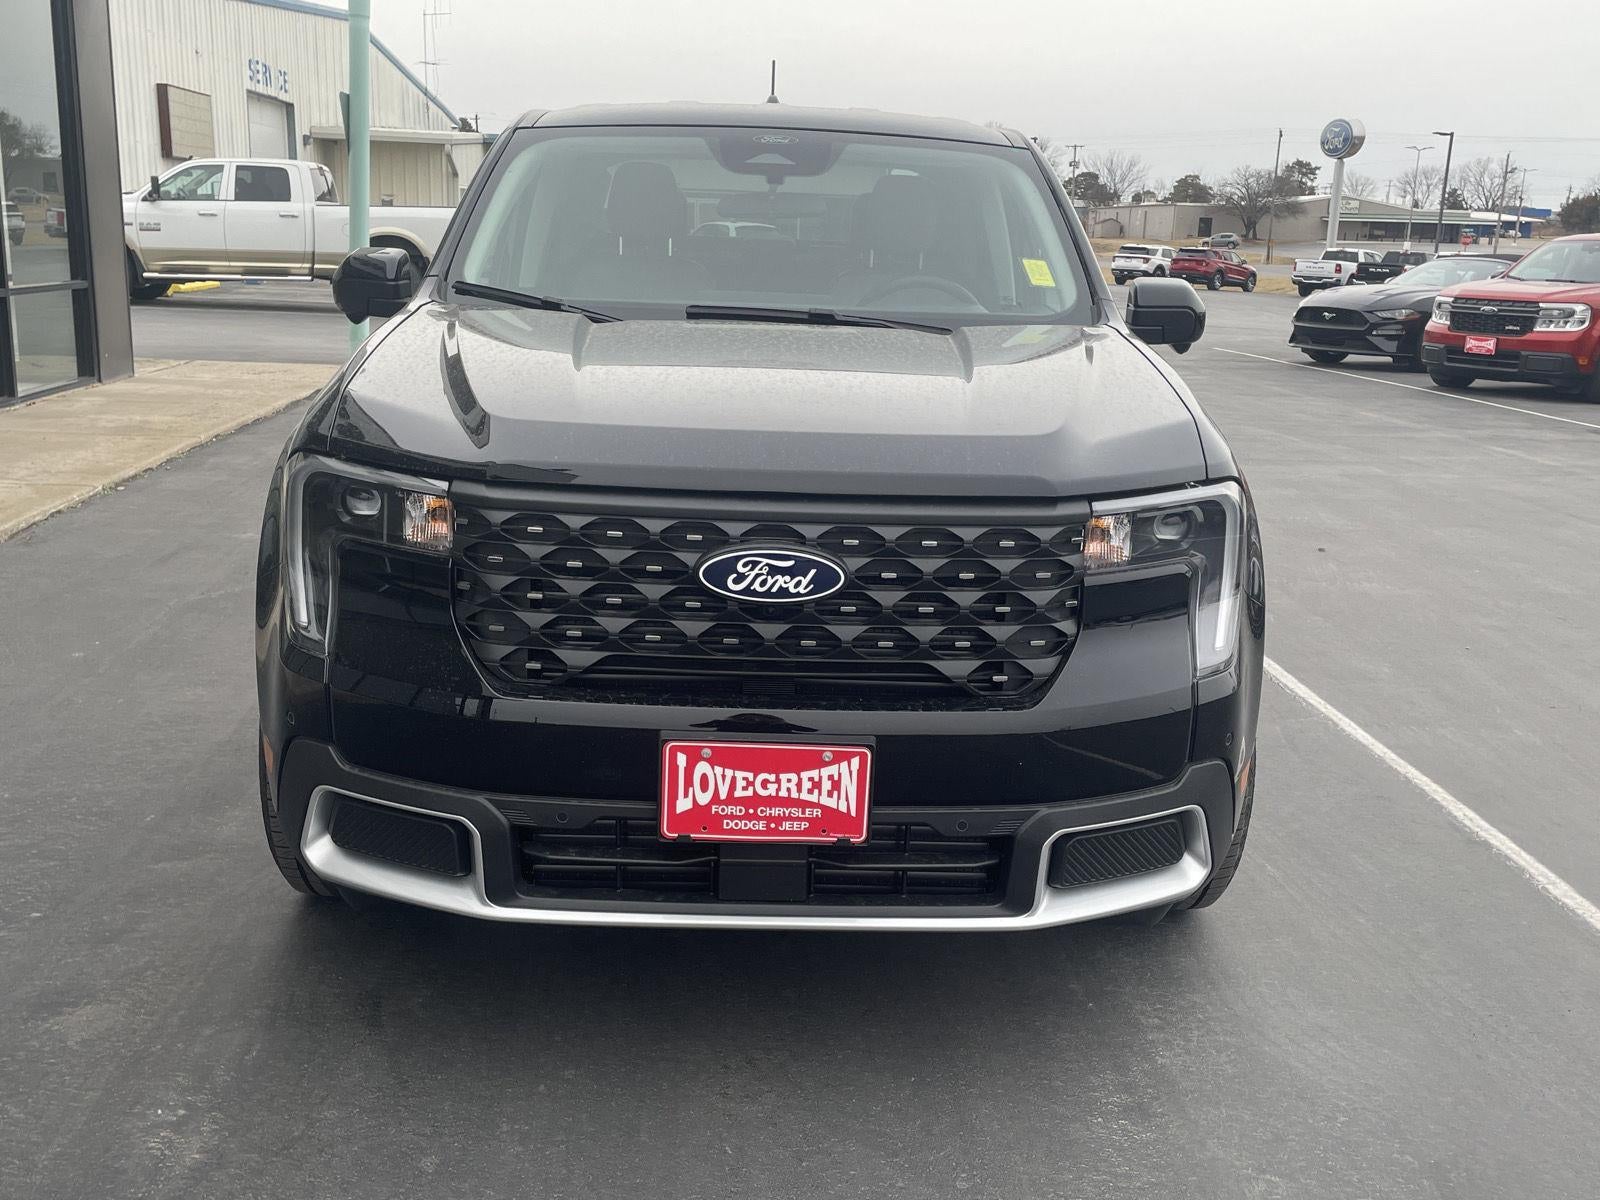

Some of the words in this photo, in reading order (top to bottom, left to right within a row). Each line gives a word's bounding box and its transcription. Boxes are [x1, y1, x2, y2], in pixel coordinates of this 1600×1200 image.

[248, 59, 288, 93] SERVCE
[1325, 127, 1346, 149] Ford
[726, 556, 817, 594] Ford
[675, 751, 860, 817] LOVEGREEN
[711, 805, 746, 816] FORD
[757, 806, 822, 818] CHRYSLER
[723, 820, 767, 831] DODGE
[778, 821, 810, 831] JEEP
